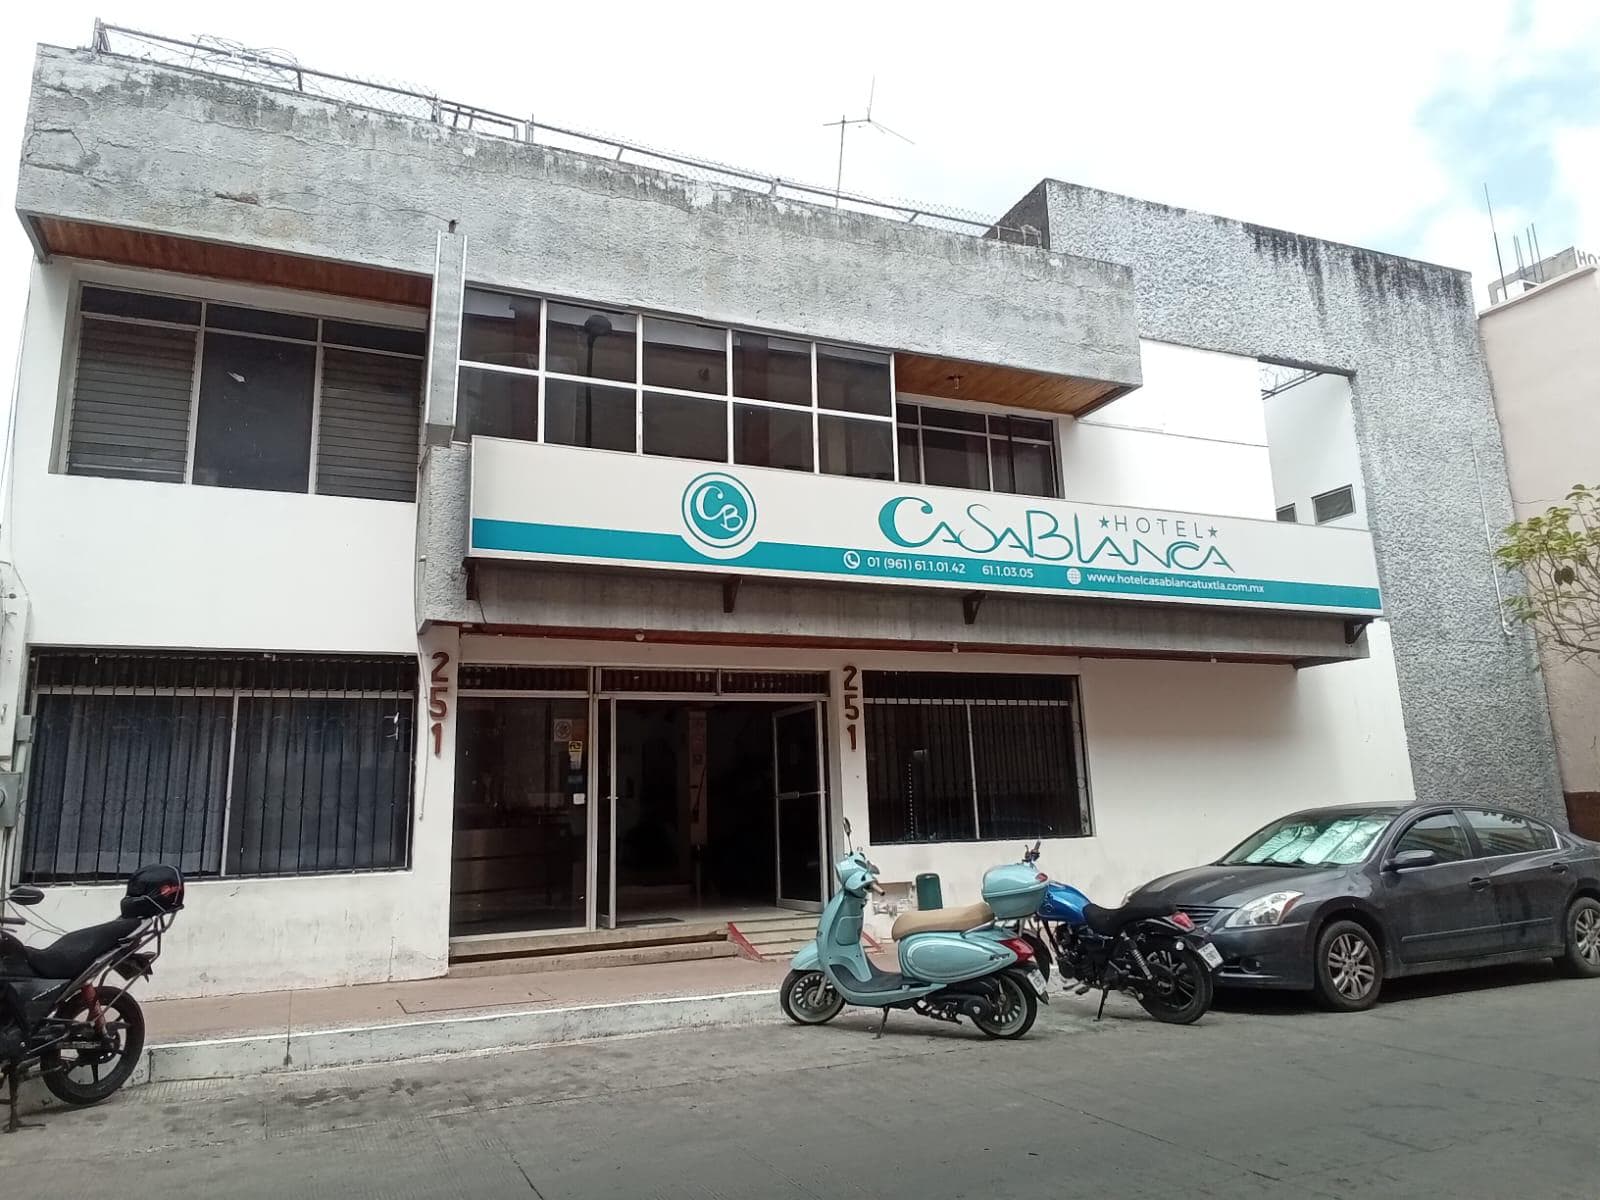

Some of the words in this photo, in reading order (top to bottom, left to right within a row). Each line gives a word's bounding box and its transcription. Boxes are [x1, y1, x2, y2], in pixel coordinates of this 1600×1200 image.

[695, 485, 744, 532] CB
[1114, 514, 1204, 540] HOTEL
[867, 556, 880, 568] 01
[883, 557, 912, 571] (961)
[914, 558, 966, 574] 61.1.01.42
[982, 565, 1034, 579] 61.1.03.05
[1087, 573, 1265, 593] www.hotelcasablancatuxtla.com.mx
[429, 651, 450, 759] 251
[843, 665, 860, 751] 251
